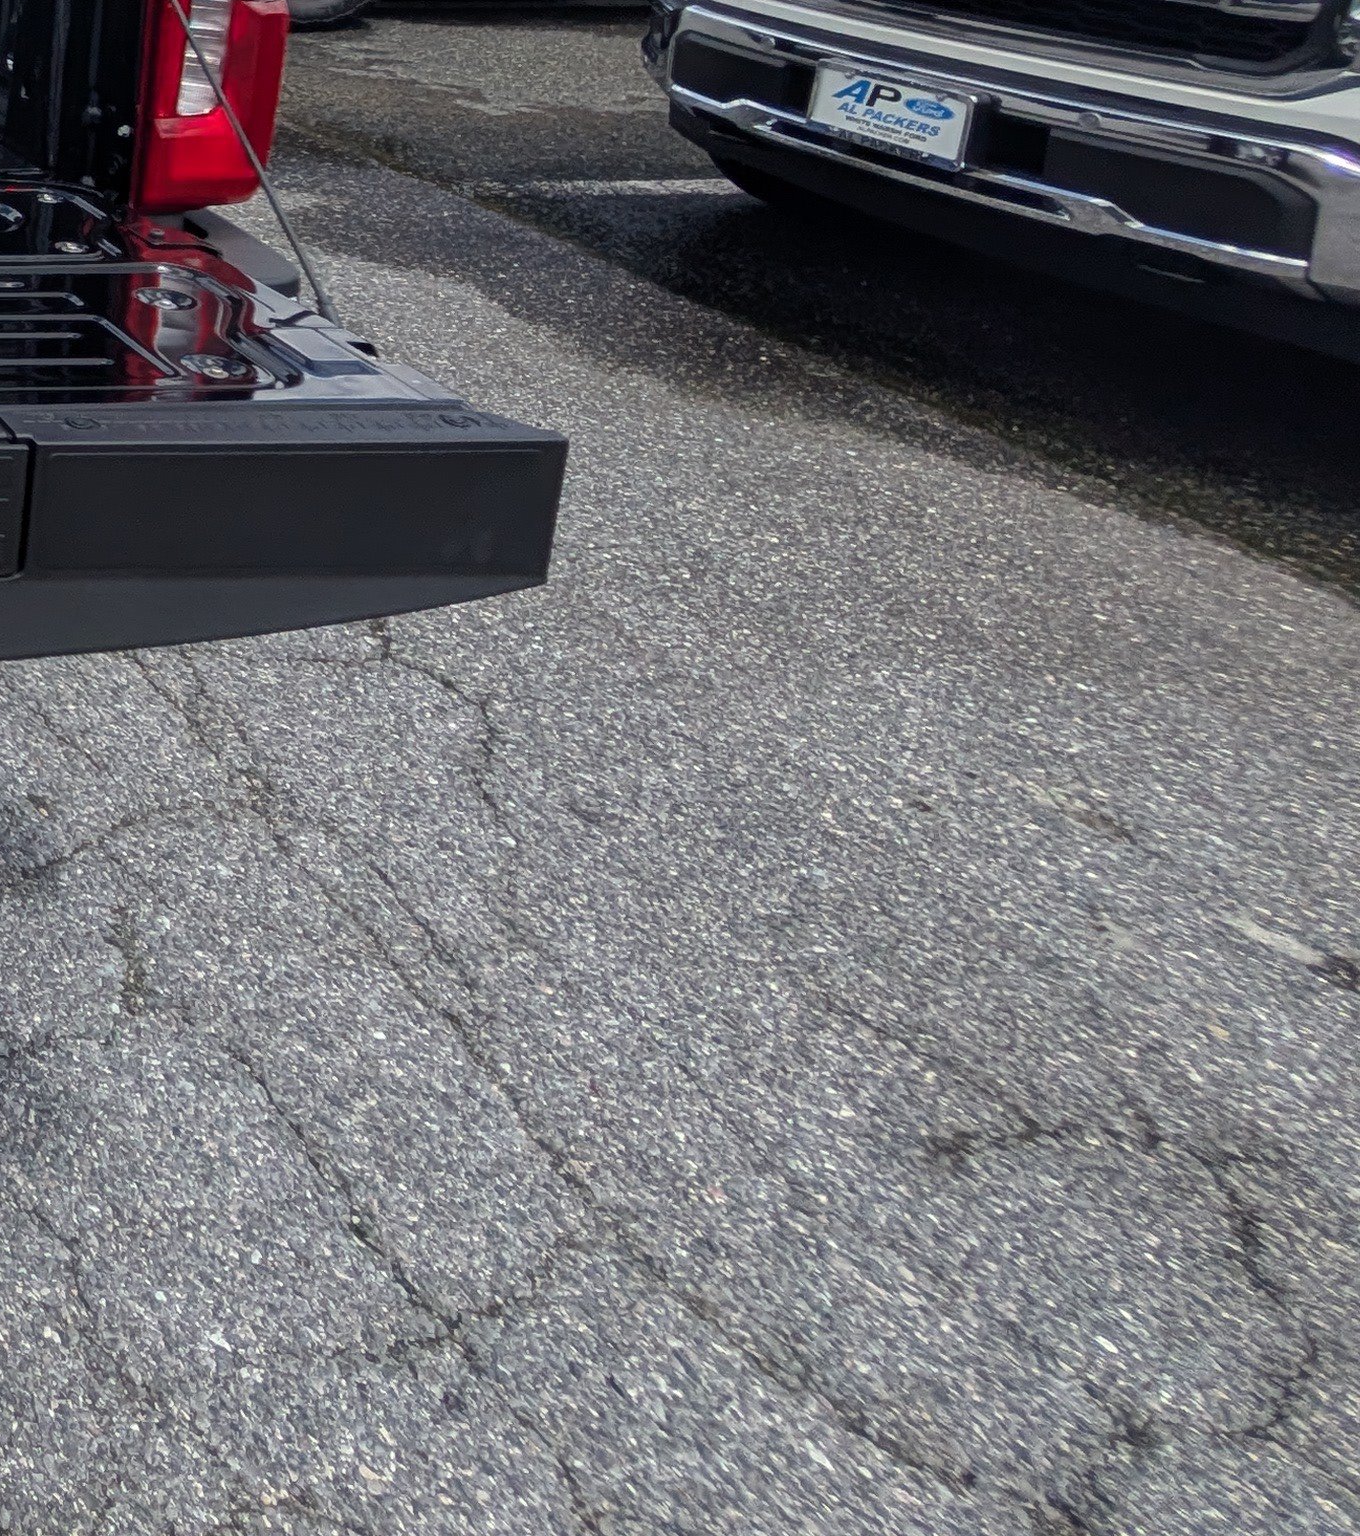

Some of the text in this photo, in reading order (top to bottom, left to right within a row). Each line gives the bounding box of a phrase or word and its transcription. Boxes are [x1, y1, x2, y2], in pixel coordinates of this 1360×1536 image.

[833, 79, 903, 107] AP
[837, 102, 941, 137] AL PACKERS
